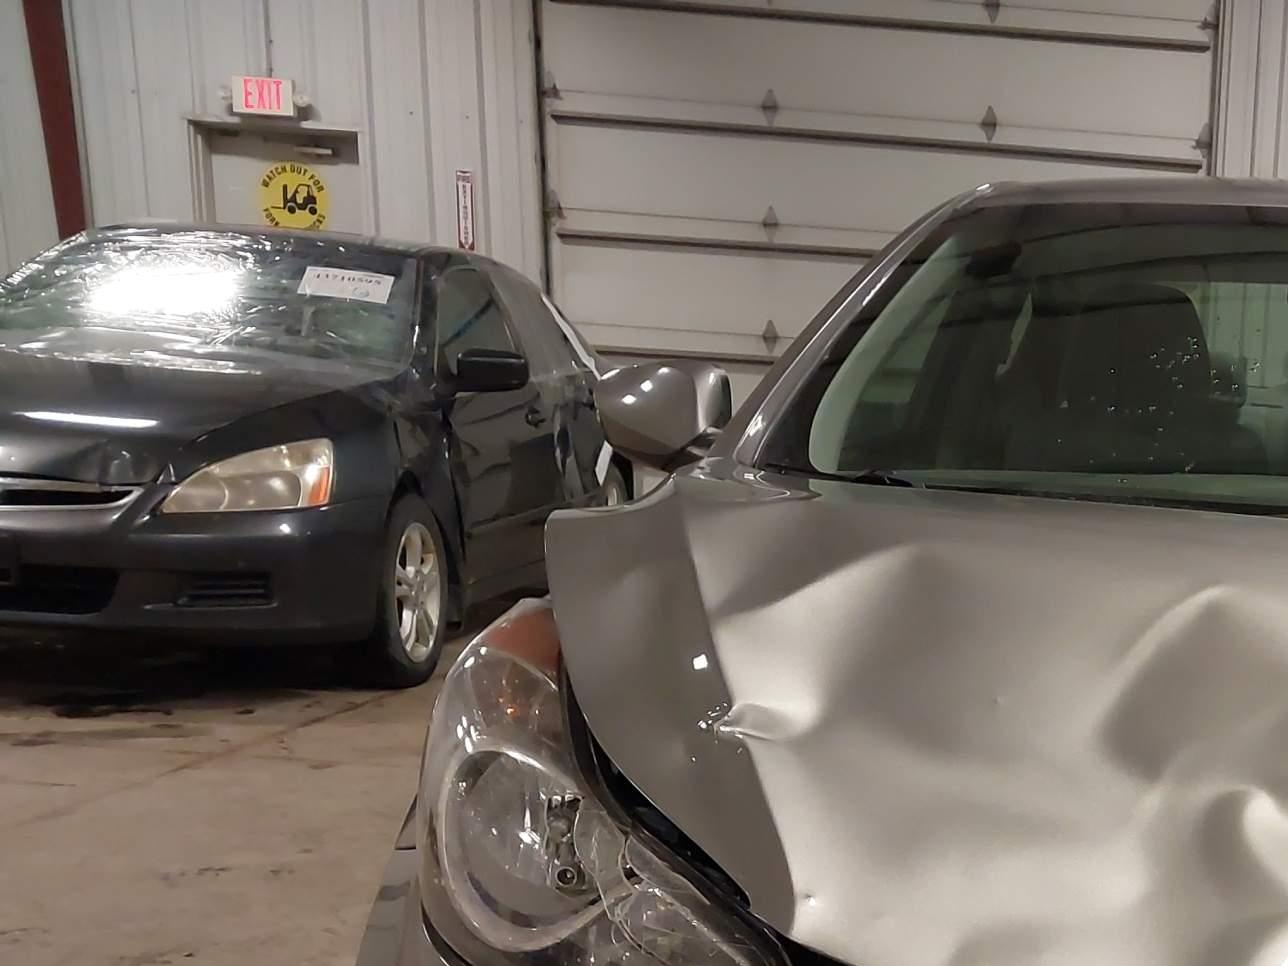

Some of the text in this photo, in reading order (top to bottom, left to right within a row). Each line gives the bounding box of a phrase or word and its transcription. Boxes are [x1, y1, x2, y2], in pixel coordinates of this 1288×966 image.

[243, 78, 282, 110] EXIT
[262, 164, 324, 193] WATCH OUT FOR
[263, 207, 280, 226] FORK
